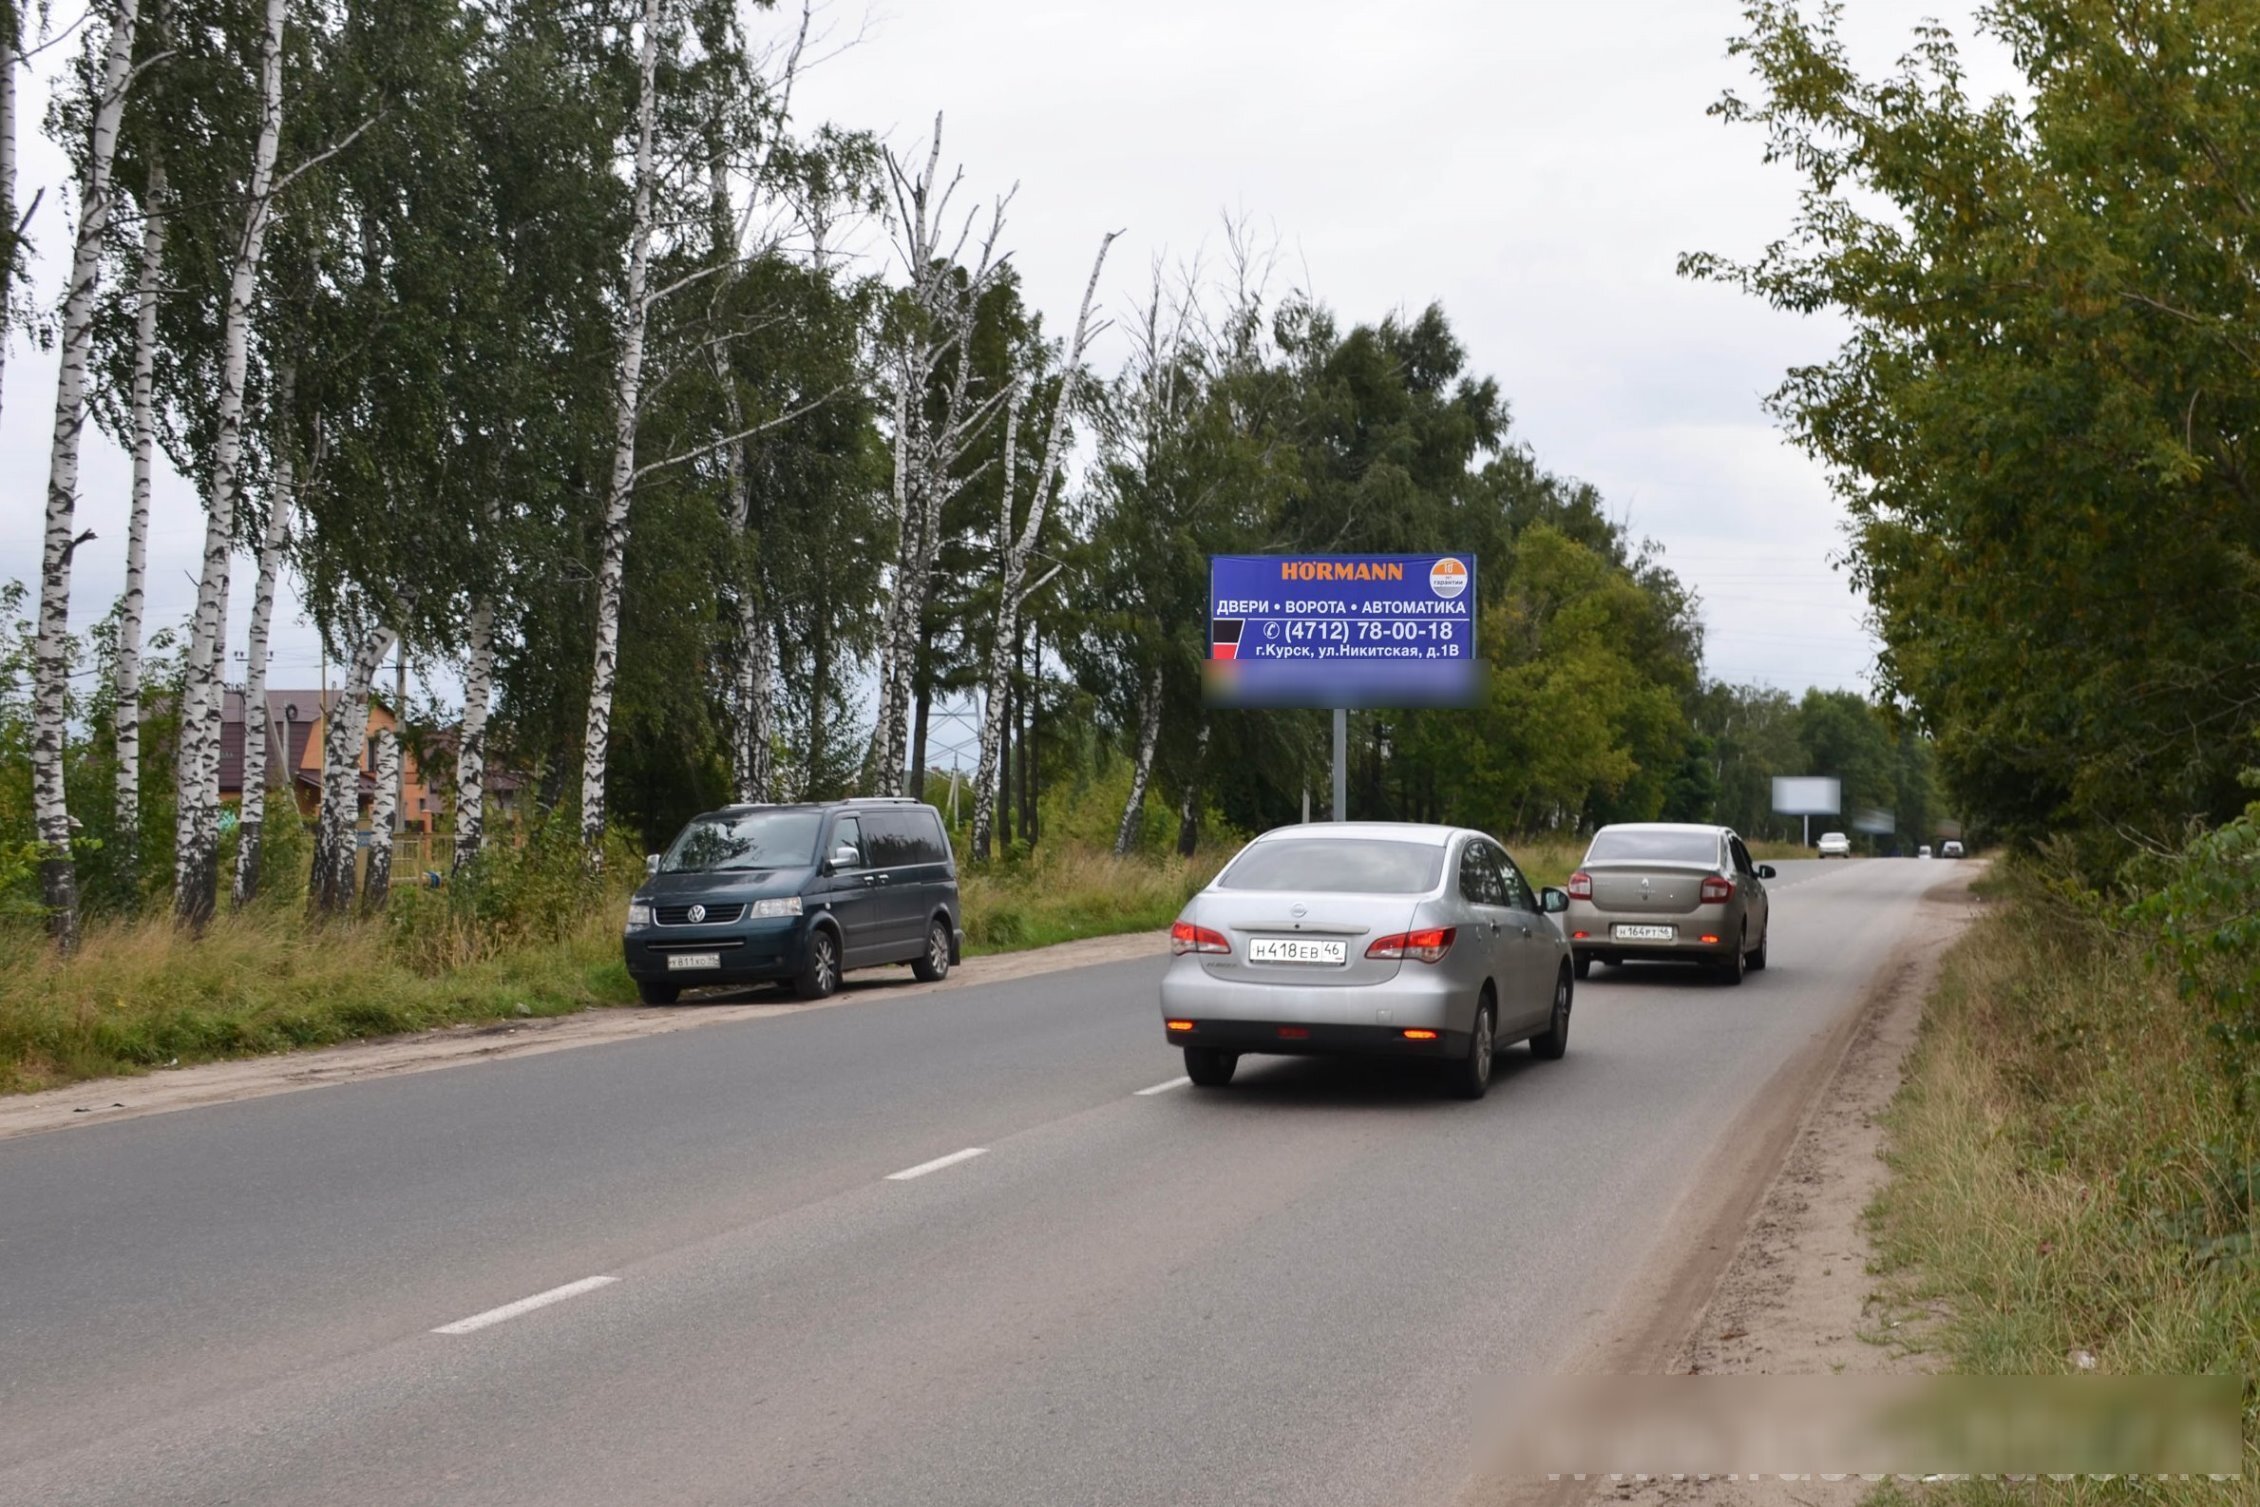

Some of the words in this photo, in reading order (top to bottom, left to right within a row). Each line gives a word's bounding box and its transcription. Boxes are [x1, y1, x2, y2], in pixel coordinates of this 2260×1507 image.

[1216, 600, 1269, 616] ДВЕРИ
[1285, 600, 1347, 614] ВОРОТА
[1361, 601, 1466, 614] АВТОМАТИКА
[1284, 620, 1350, 644] (4712)
[1357, 621, 1453, 640] 78-00-18
[1255, 643, 1315, 659] г.Курск,
[1318, 644, 1422, 659] ул.Никитская,
[1426, 644, 1460, 659] д.1В
[1256, 942, 1319, 959] Н418ЕВ
[1324, 943, 1340, 956] 46
